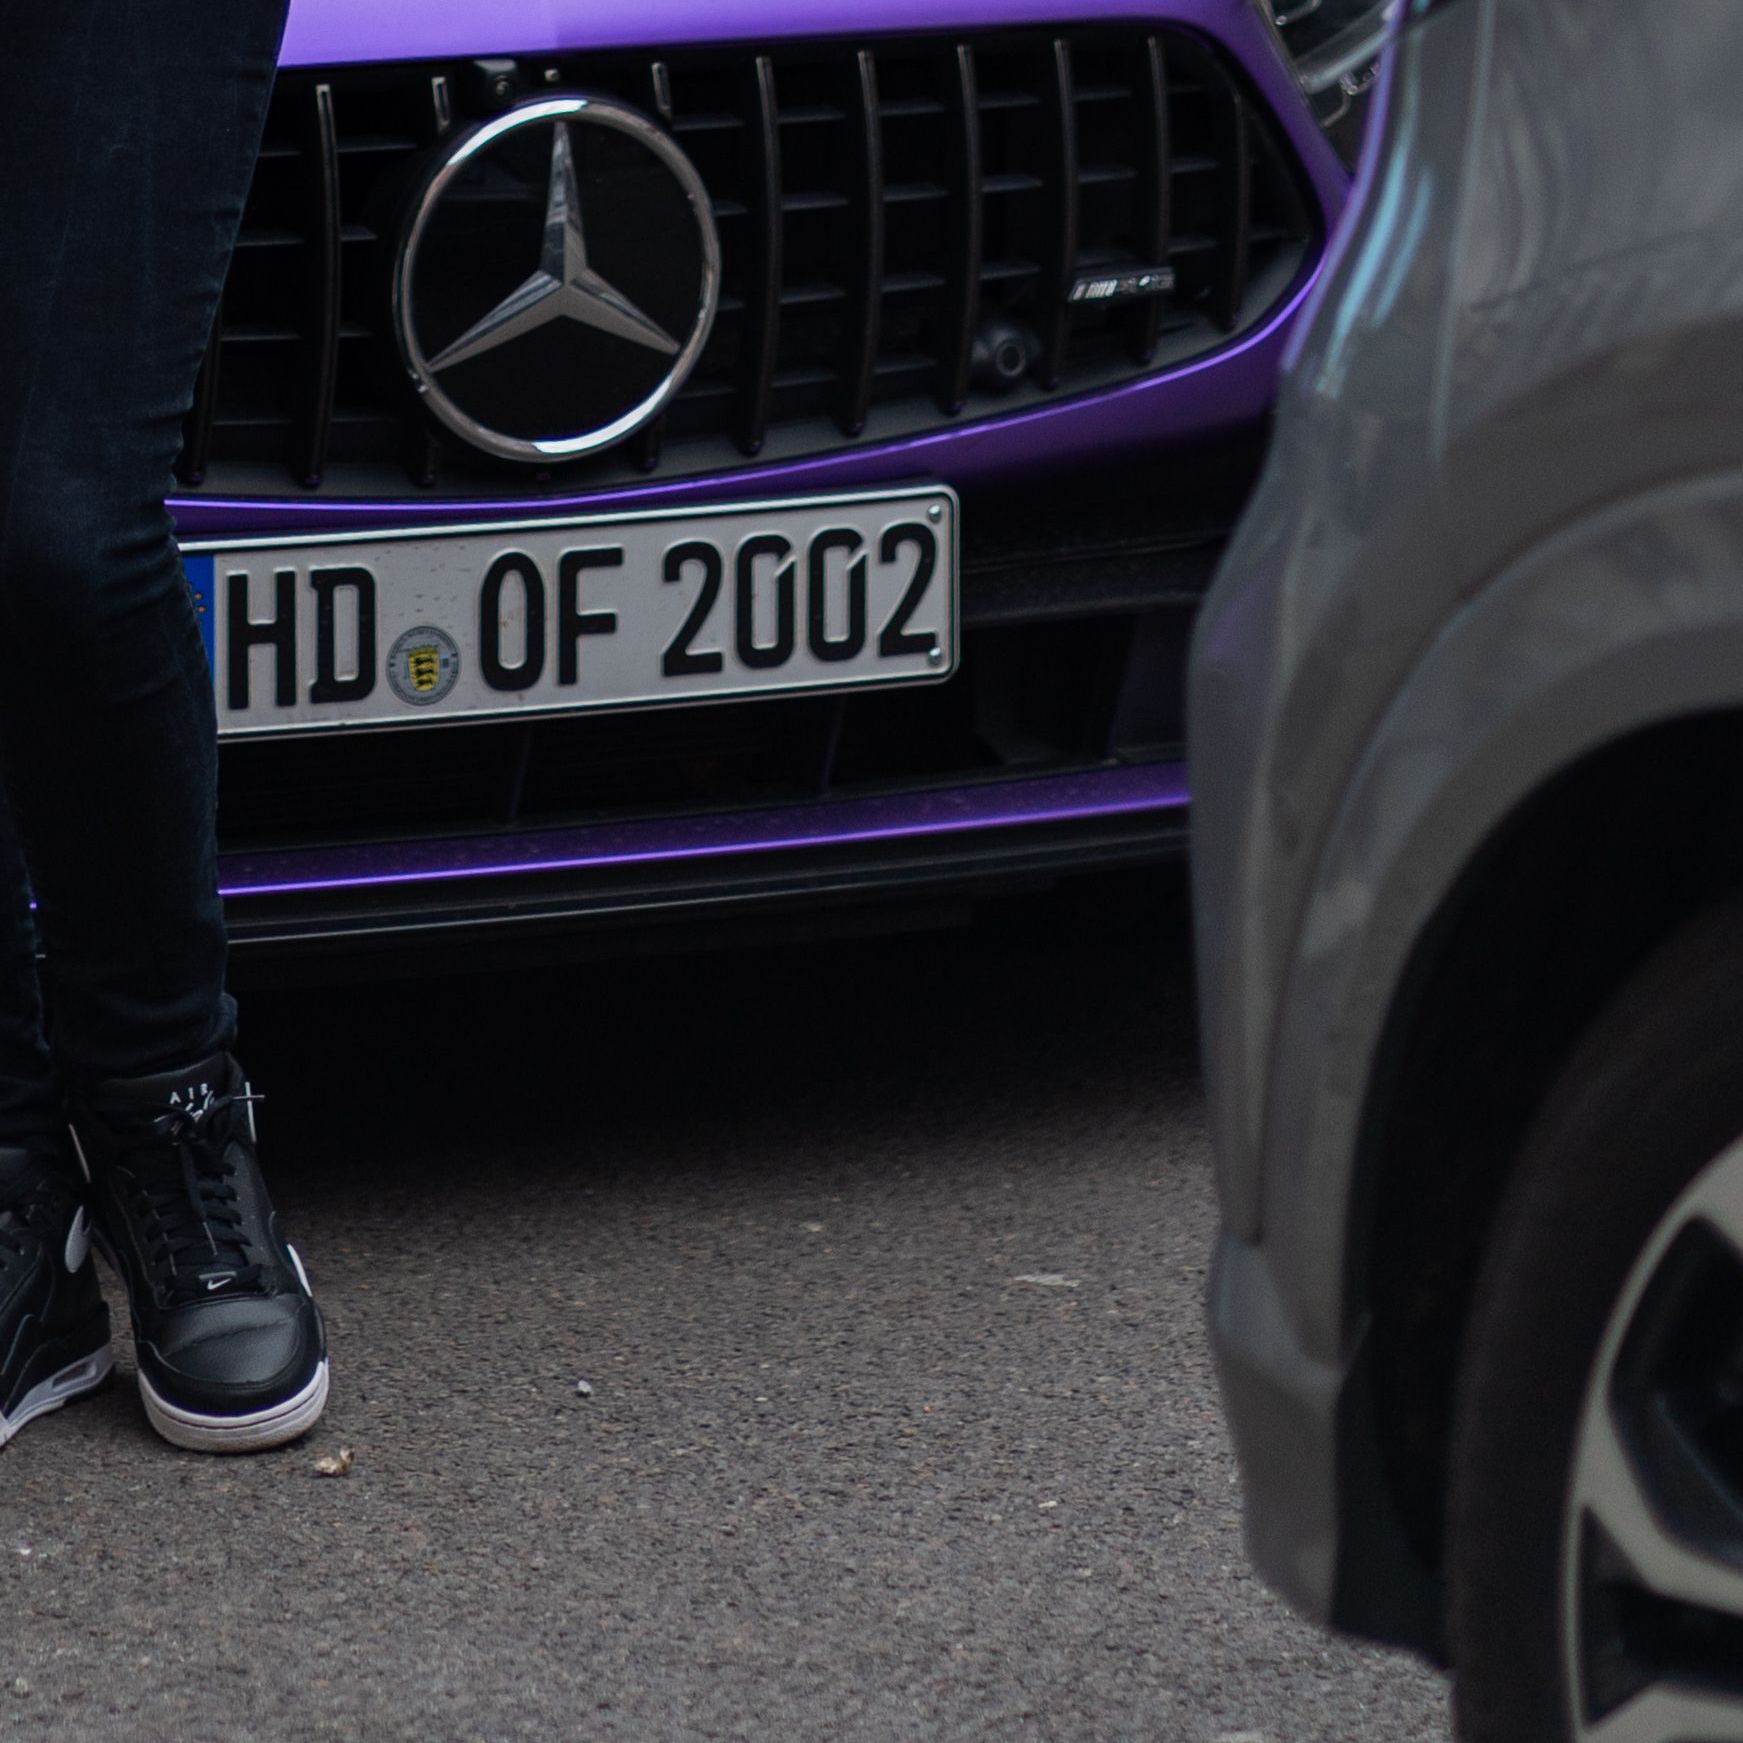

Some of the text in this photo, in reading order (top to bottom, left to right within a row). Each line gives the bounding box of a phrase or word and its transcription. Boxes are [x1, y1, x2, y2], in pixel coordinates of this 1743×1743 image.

[227, 566, 376, 710] HD
[480, 546, 624, 692] OF
[661, 521, 938, 677] 2002
[169, 1082, 209, 1105] AIR
